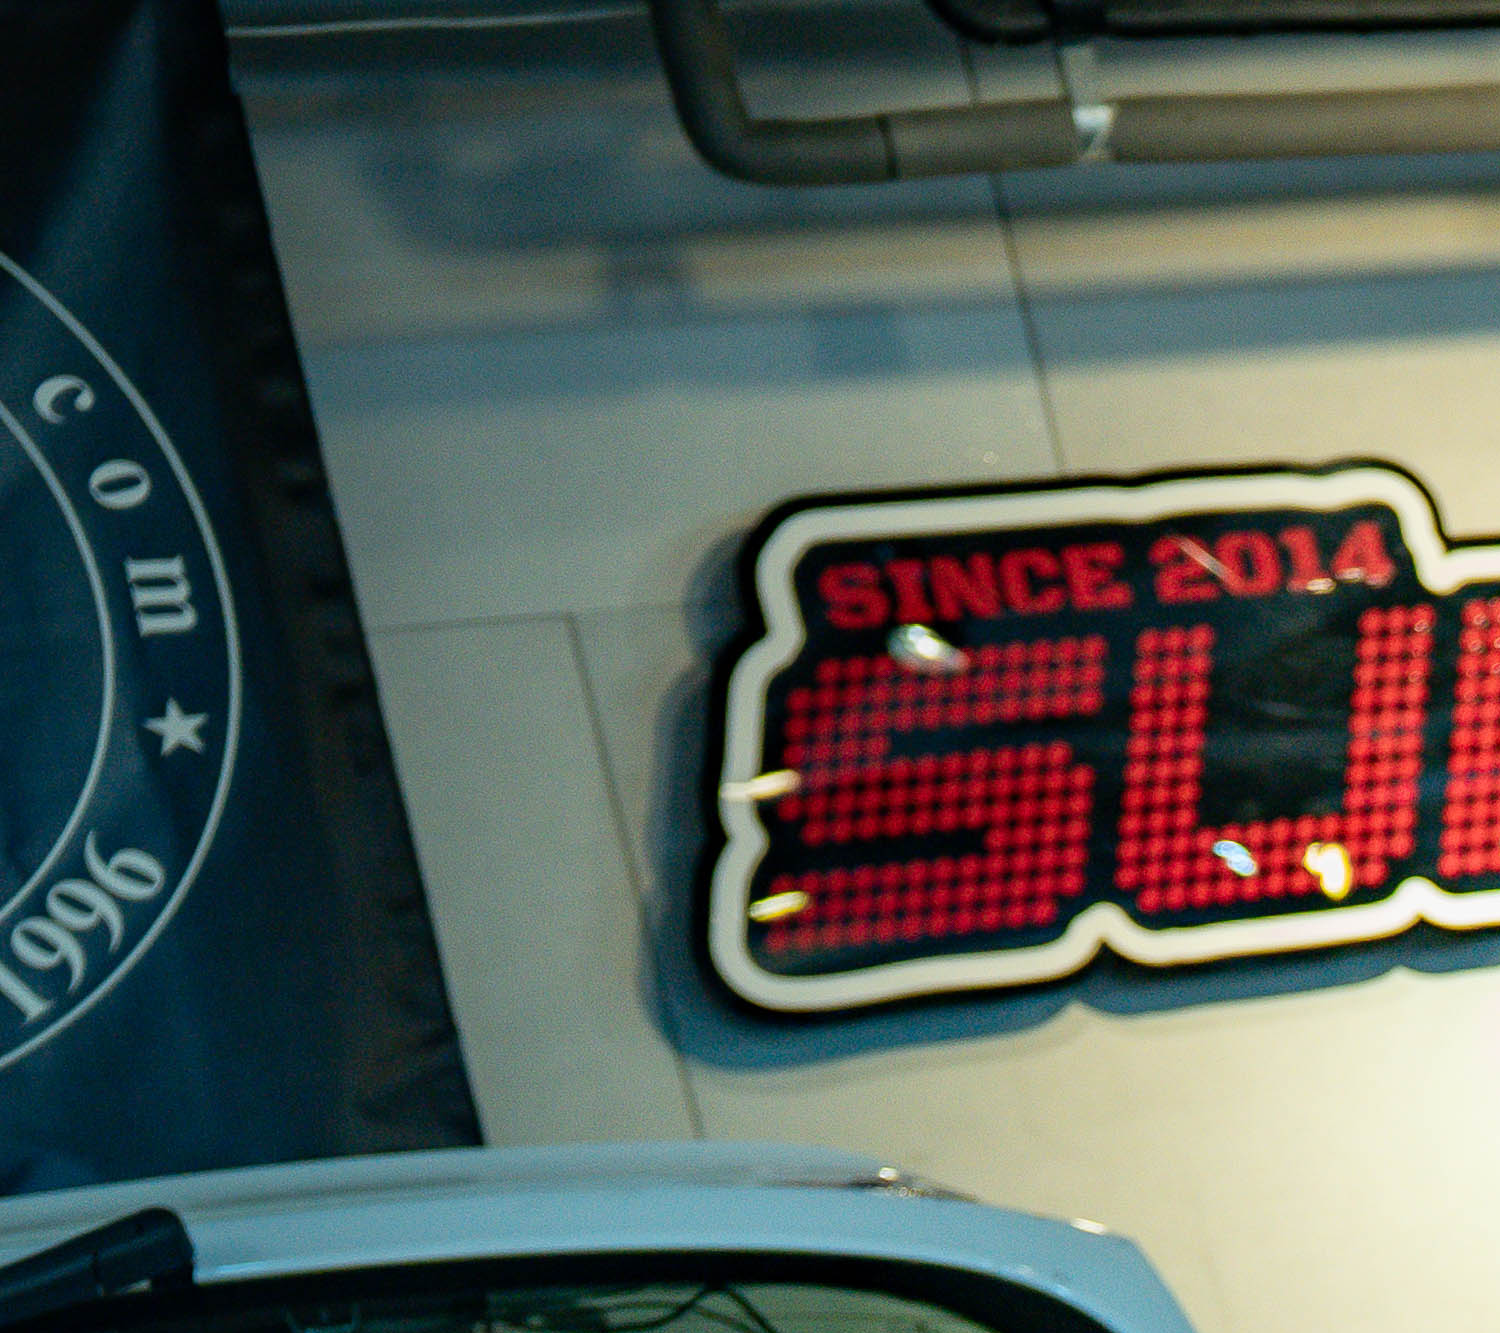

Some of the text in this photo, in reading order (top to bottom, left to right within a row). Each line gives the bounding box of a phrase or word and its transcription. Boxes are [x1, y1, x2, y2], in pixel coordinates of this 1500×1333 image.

[817, 519, 1396, 630] SINCE 2014
[0, 829, 166, 1025] 1996
